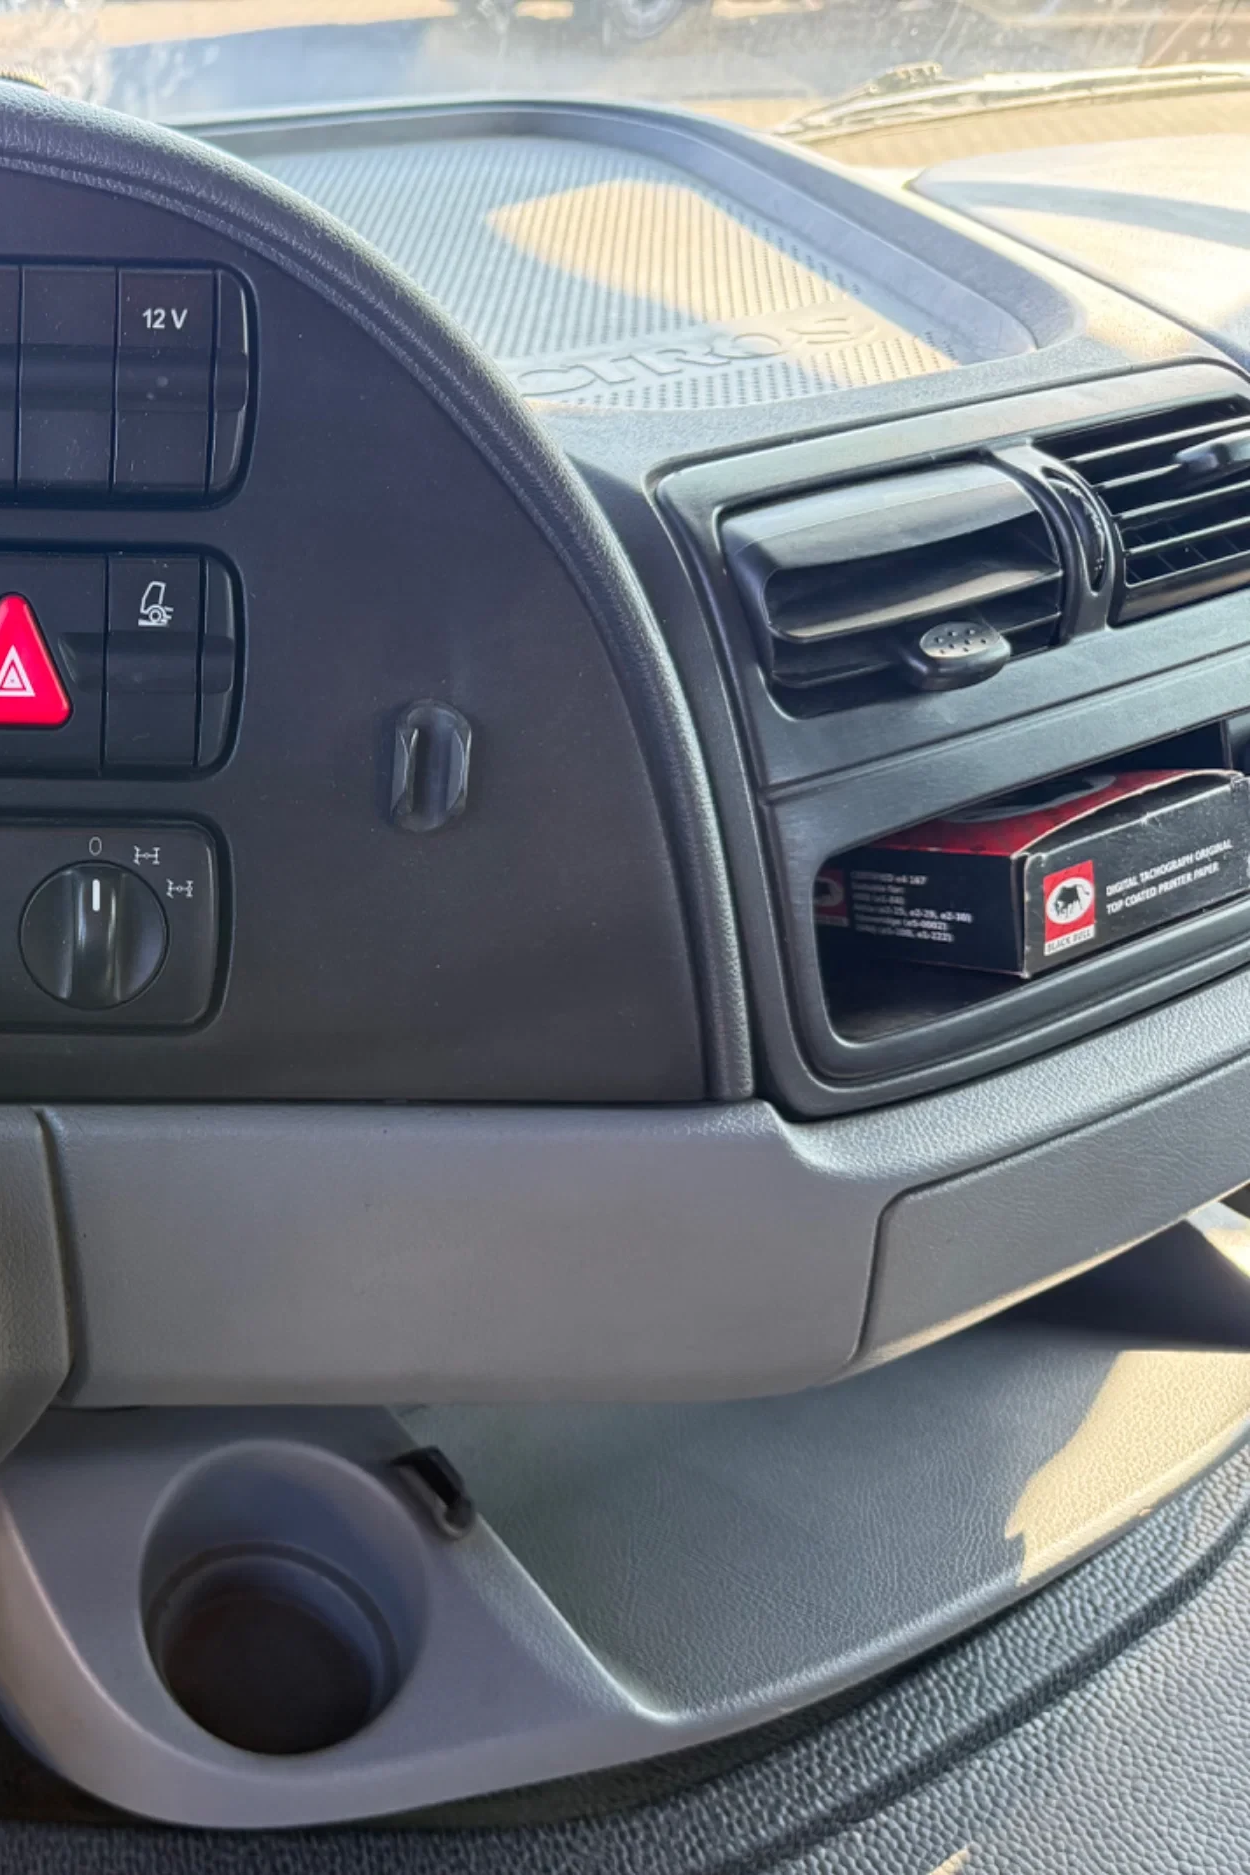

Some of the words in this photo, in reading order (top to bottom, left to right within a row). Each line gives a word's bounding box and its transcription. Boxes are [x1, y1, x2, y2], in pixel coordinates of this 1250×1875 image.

[512, 306, 878, 398] CTROS
[1106, 875, 1139, 897] DIGITAL
[1139, 853, 1194, 883] TACHOGRAPH
[1195, 838, 1233, 861] ORIGINAL
[1106, 899, 1124, 915] TOP
[1125, 886, 1157, 908] COATED
[1158, 872, 1193, 895] PRINTER
[1193, 861, 1220, 881] PAPER
